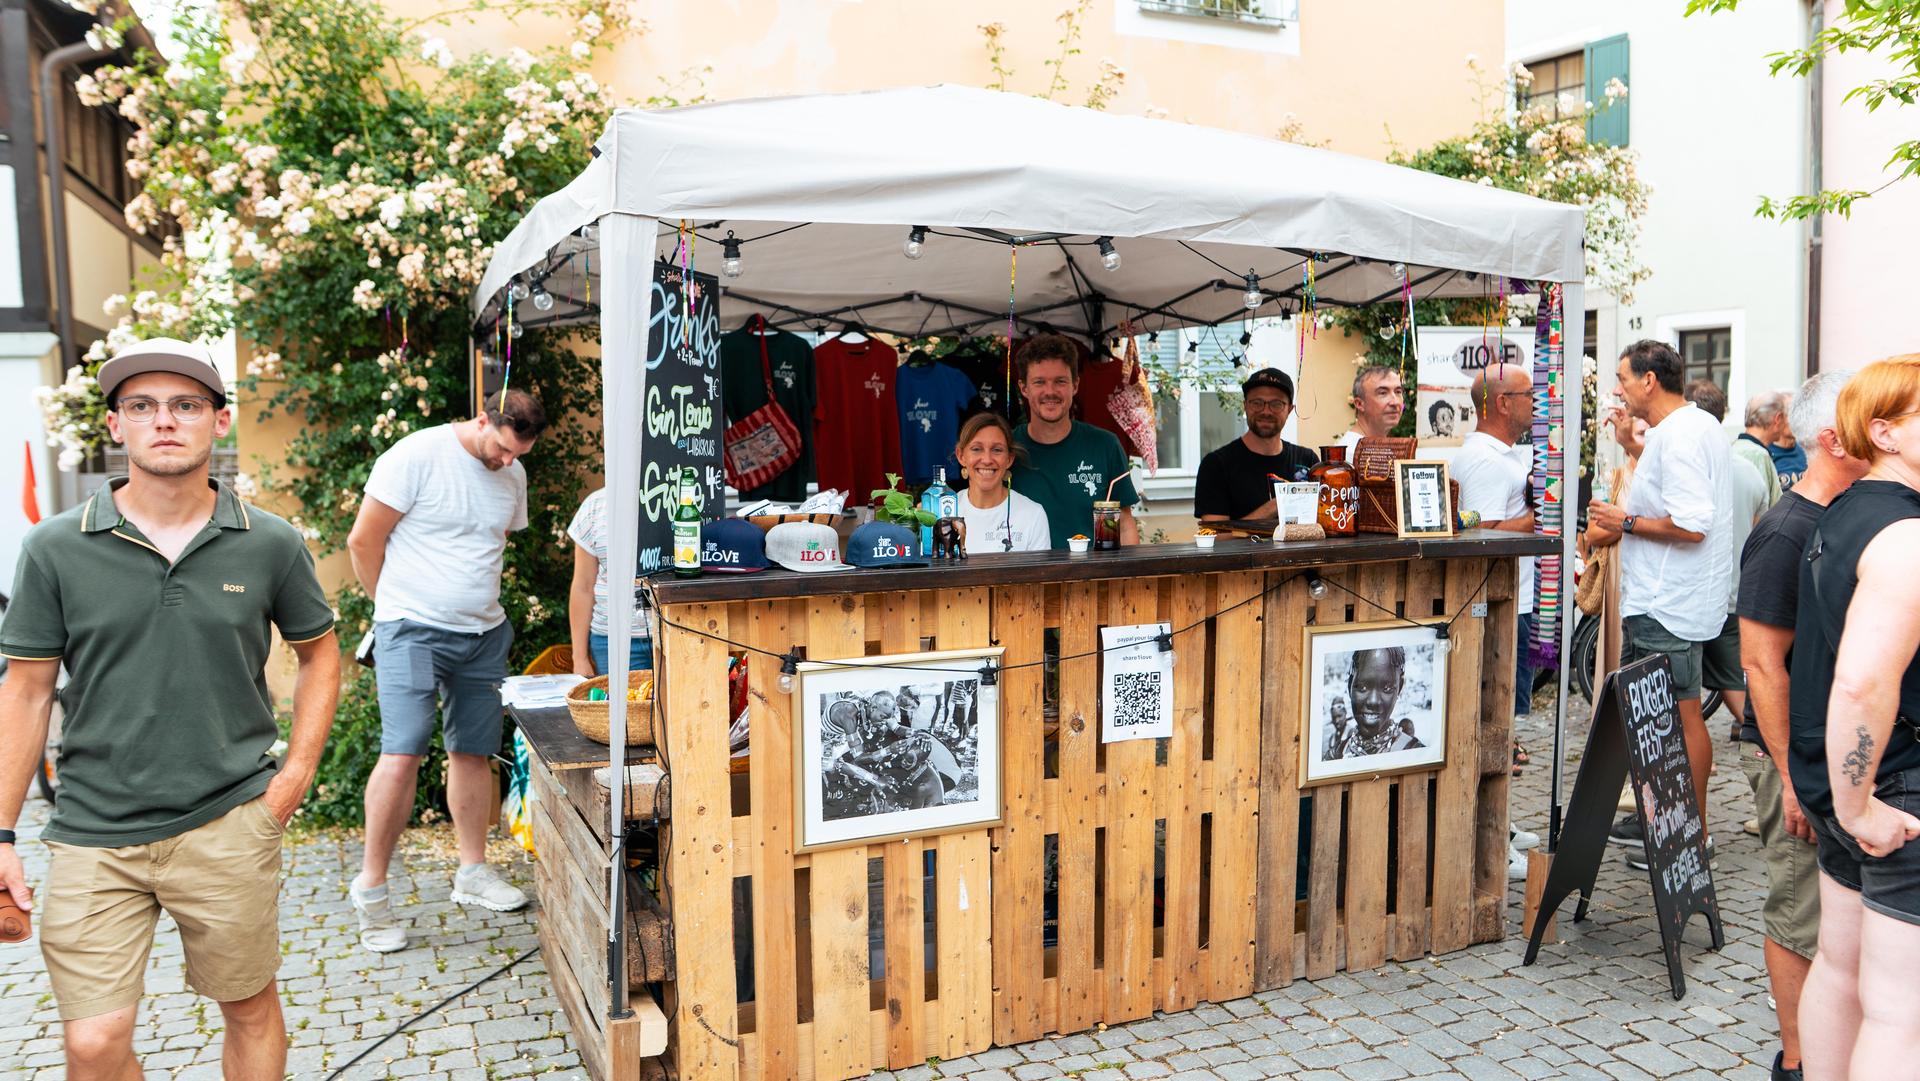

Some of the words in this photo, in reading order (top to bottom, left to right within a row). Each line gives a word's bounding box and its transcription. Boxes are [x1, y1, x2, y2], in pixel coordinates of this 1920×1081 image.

[647, 384, 680, 446] Gin
[671, 385, 713, 438] Tonic
[1077, 460, 1094, 473] share
[1068, 473, 1102, 484] 1LOVE
[1411, 471, 1436, 480] Follow
[640, 461, 705, 523] Eiste
[705, 539, 718, 552] share
[877, 535, 892, 547] share
[640, 545, 661, 570] 100%
[702, 550, 739, 563] 1LOVE
[800, 549, 837, 562] 1LOVE
[872, 543, 911, 559] 1LOVE
[223, 583, 245, 593] BOSS
[1628, 667, 1673, 723] BURGER
[1637, 714, 1673, 768] FEST
